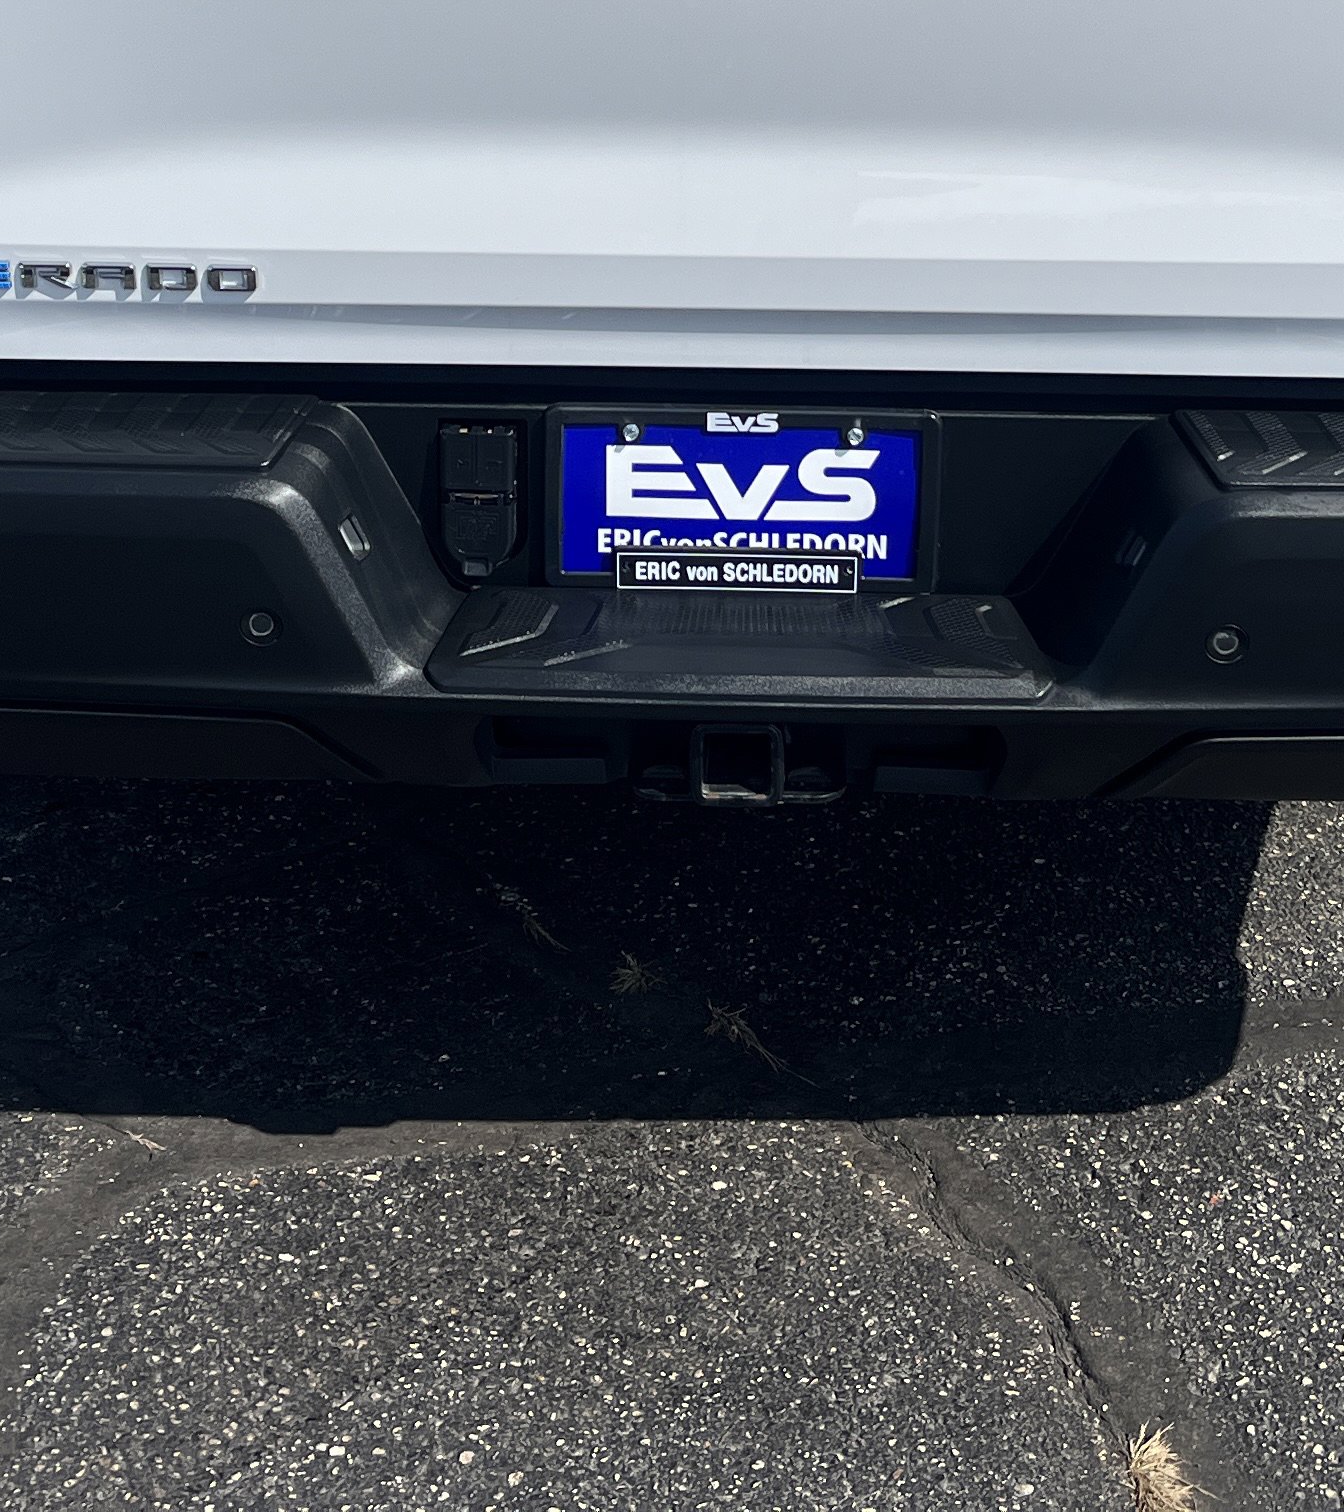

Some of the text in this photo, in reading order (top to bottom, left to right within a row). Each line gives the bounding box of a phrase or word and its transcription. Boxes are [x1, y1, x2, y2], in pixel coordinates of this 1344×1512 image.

[635, 561, 839, 584] ERIC von SCHLEDORN
